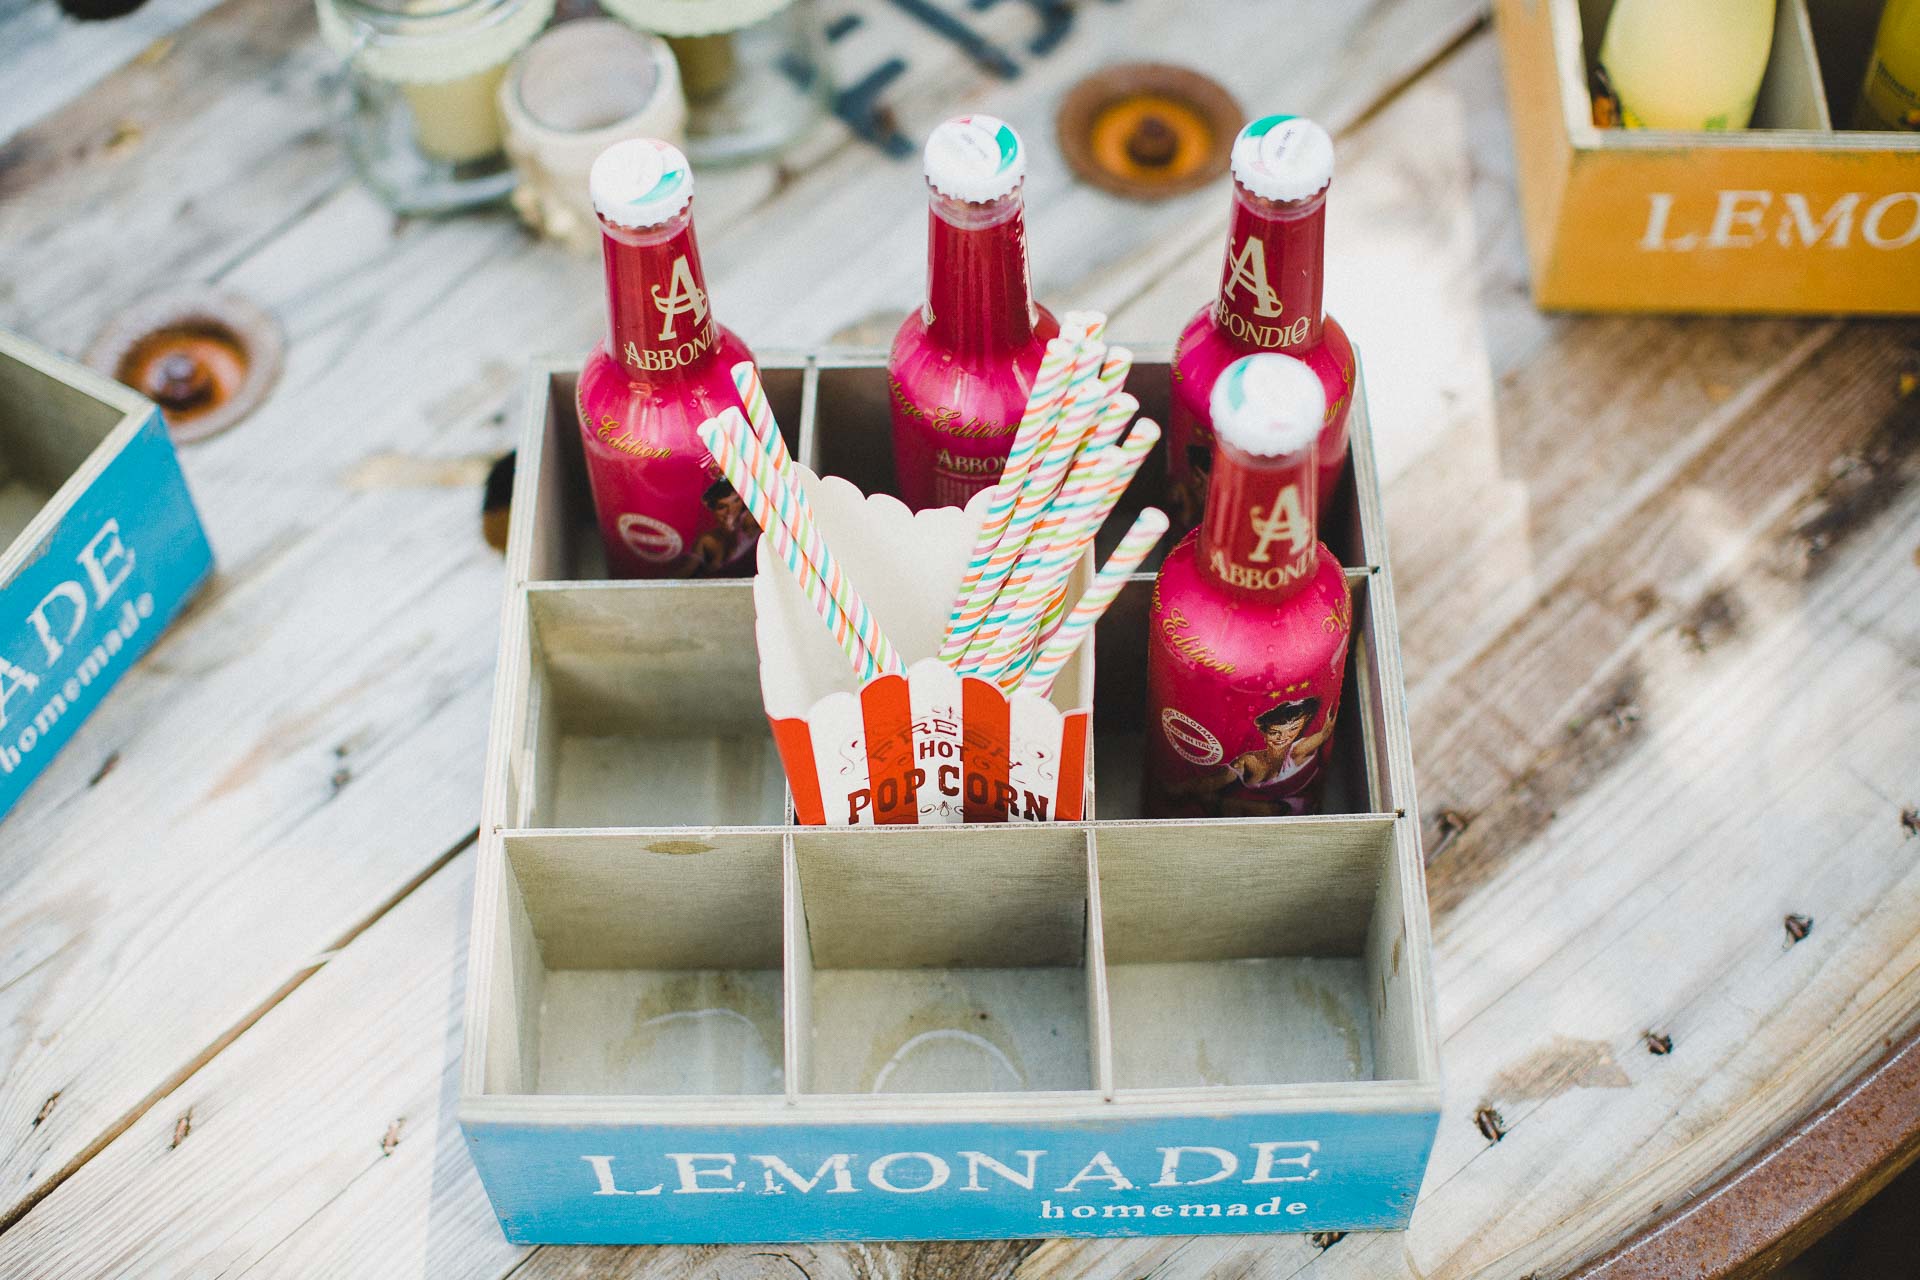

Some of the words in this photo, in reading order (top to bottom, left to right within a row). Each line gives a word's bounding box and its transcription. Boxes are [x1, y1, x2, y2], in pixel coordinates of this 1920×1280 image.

[1636, 190, 1920, 251] LEMO
[651, 254, 708, 341] A
[1224, 236, 1283, 318] A
[597, 415, 672, 459] Edition
[1248, 484, 1311, 562] A
[1162, 607, 1236, 675] Edition
[919, 741, 968, 762] HOT
[580, 1141, 1320, 1195] LEMONADE
[1040, 1197, 1308, 1219] homemade
